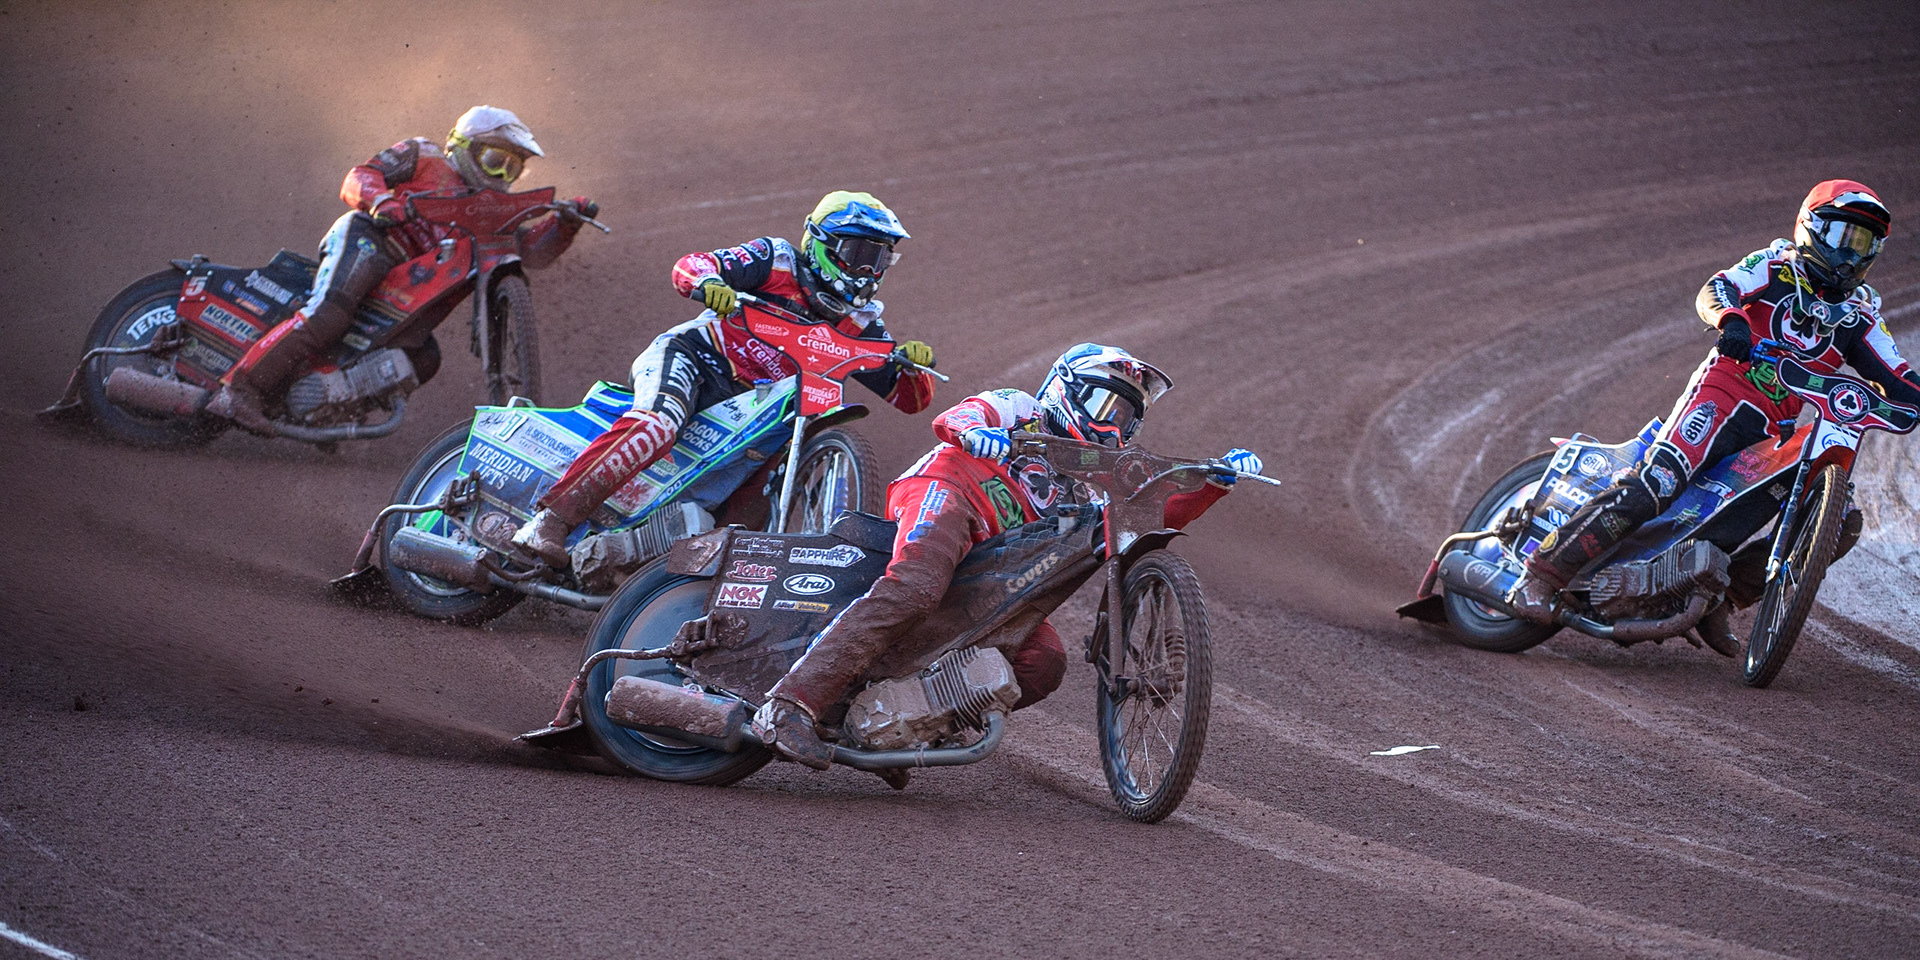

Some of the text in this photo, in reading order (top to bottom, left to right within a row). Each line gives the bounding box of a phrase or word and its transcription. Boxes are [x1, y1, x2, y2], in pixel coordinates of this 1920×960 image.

[185, 276, 208, 297] 5
[126, 304, 177, 341] TENG
[797, 334, 850, 358] Crendon
[746, 338, 787, 380] Crendon
[469, 441, 534, 483] MERIDIAN
[1558, 446, 1578, 471] 5
[475, 464, 509, 490] LIFTS
[1546, 476, 1593, 505] POLCO
[791, 549, 848, 562] SAPPHIRE
[732, 560, 777, 579] Joker
[1005, 552, 1061, 594] Covers
[1471, 564, 1495, 578] ATPI
[720, 586, 765, 601] NGK
[788, 576, 827, 590] Arai
